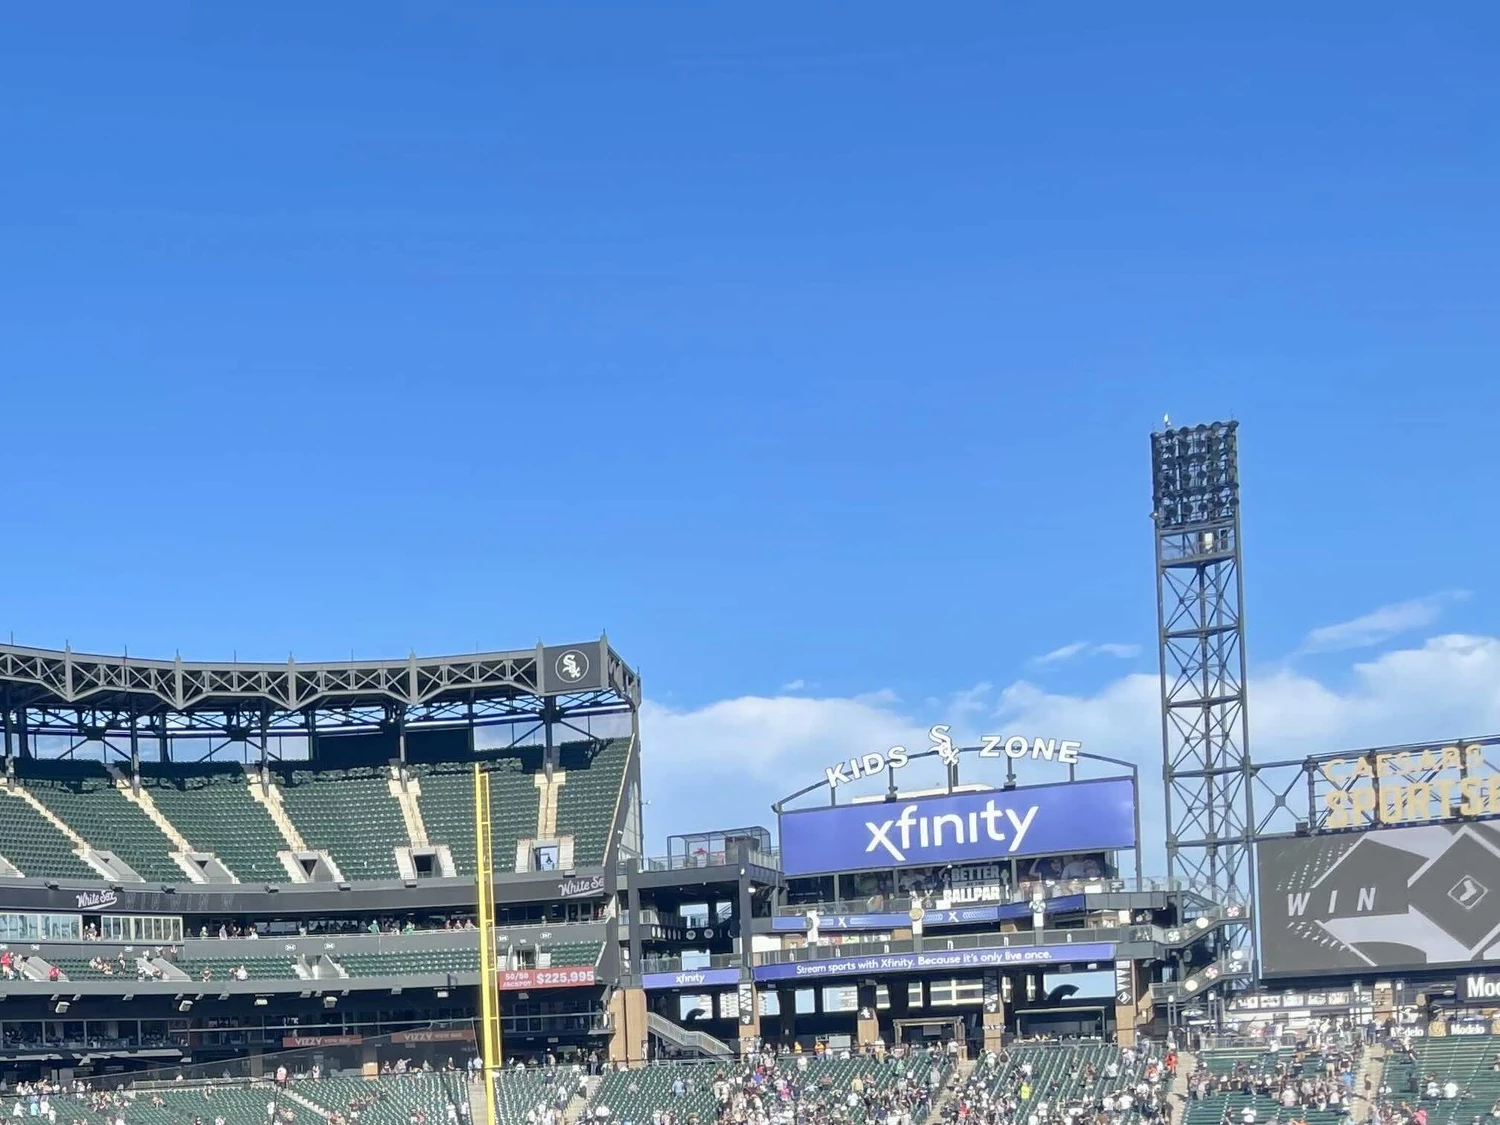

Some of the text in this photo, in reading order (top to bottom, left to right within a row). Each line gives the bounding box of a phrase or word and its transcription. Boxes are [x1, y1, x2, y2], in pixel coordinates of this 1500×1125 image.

[825, 746, 908, 787] KIDS
[979, 735, 1082, 764] ZONE
[1324, 744, 1485, 783] CAESARS
[864, 799, 1040, 861] xfinity
[950, 865, 1000, 882] BETTER
[558, 875, 604, 897] White So
[943, 886, 1010, 903] BALLPAR
[75, 890, 117, 908] White Sox
[1288, 887, 1376, 916] WIN
[797, 950, 1052, 975] Stream sports with Xfinity. Because it's only live once.
[676, 973, 705, 985] xfinity
[404, 1032, 433, 1042] VIZZY
[1451, 1024, 1485, 1035] Modelo
[294, 1037, 323, 1046] VIZZY
